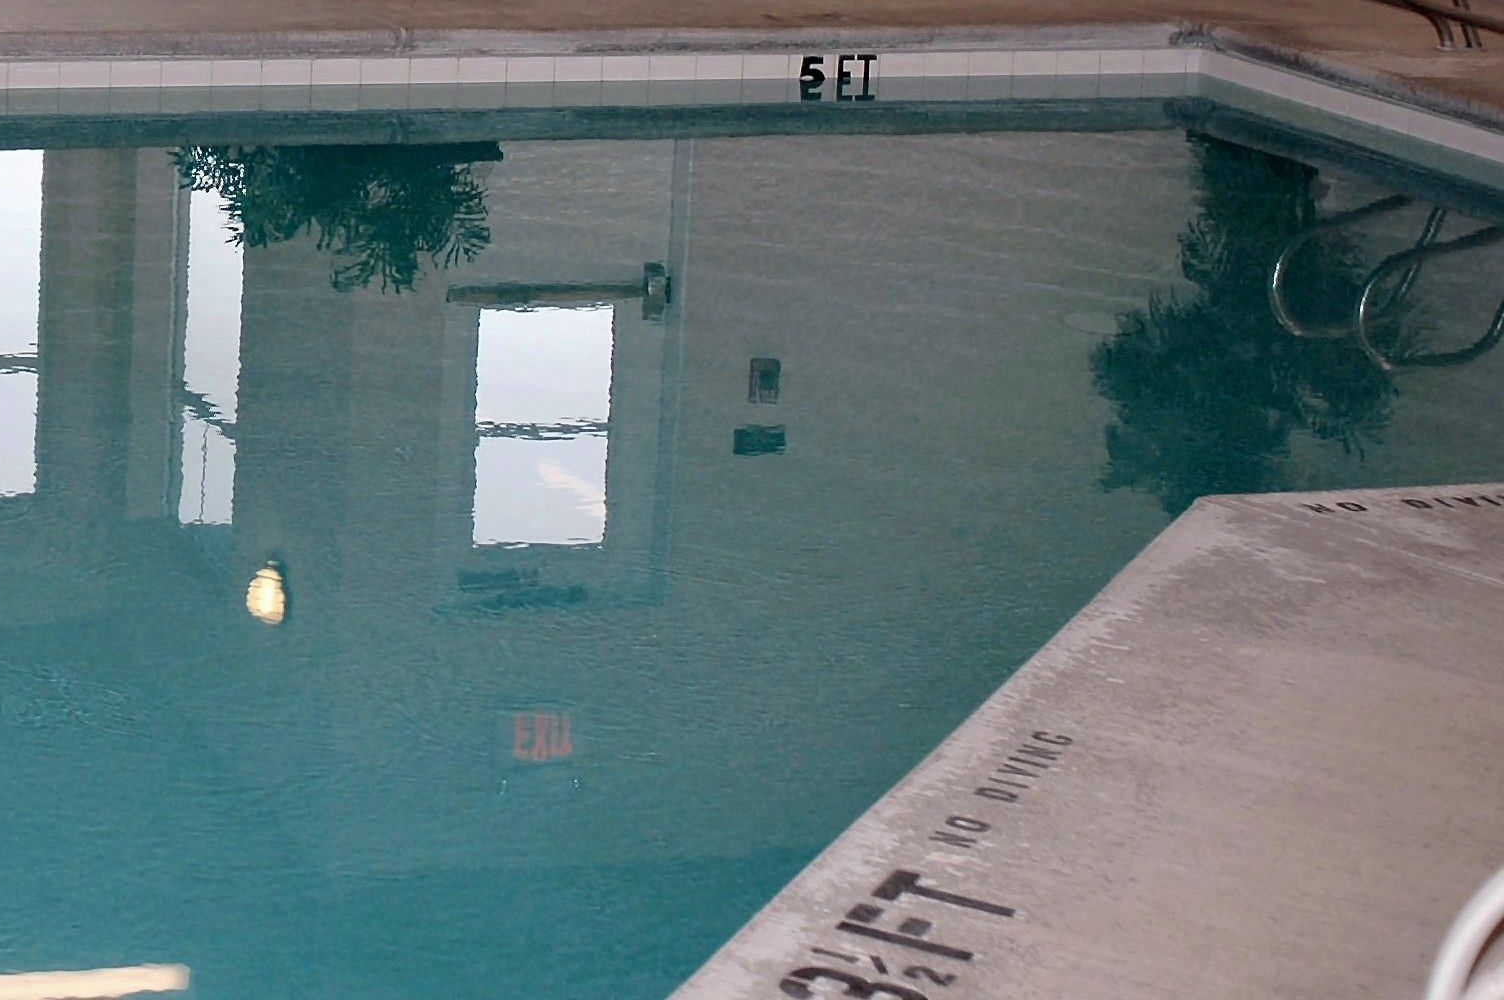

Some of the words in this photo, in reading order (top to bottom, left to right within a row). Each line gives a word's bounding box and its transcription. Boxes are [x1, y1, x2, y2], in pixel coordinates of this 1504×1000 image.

[1400, 495, 1504, 509] DIVI
[928, 815, 990, 848] NO
[975, 730, 1073, 803] DIVING
[835, 869, 1016, 961] FT
